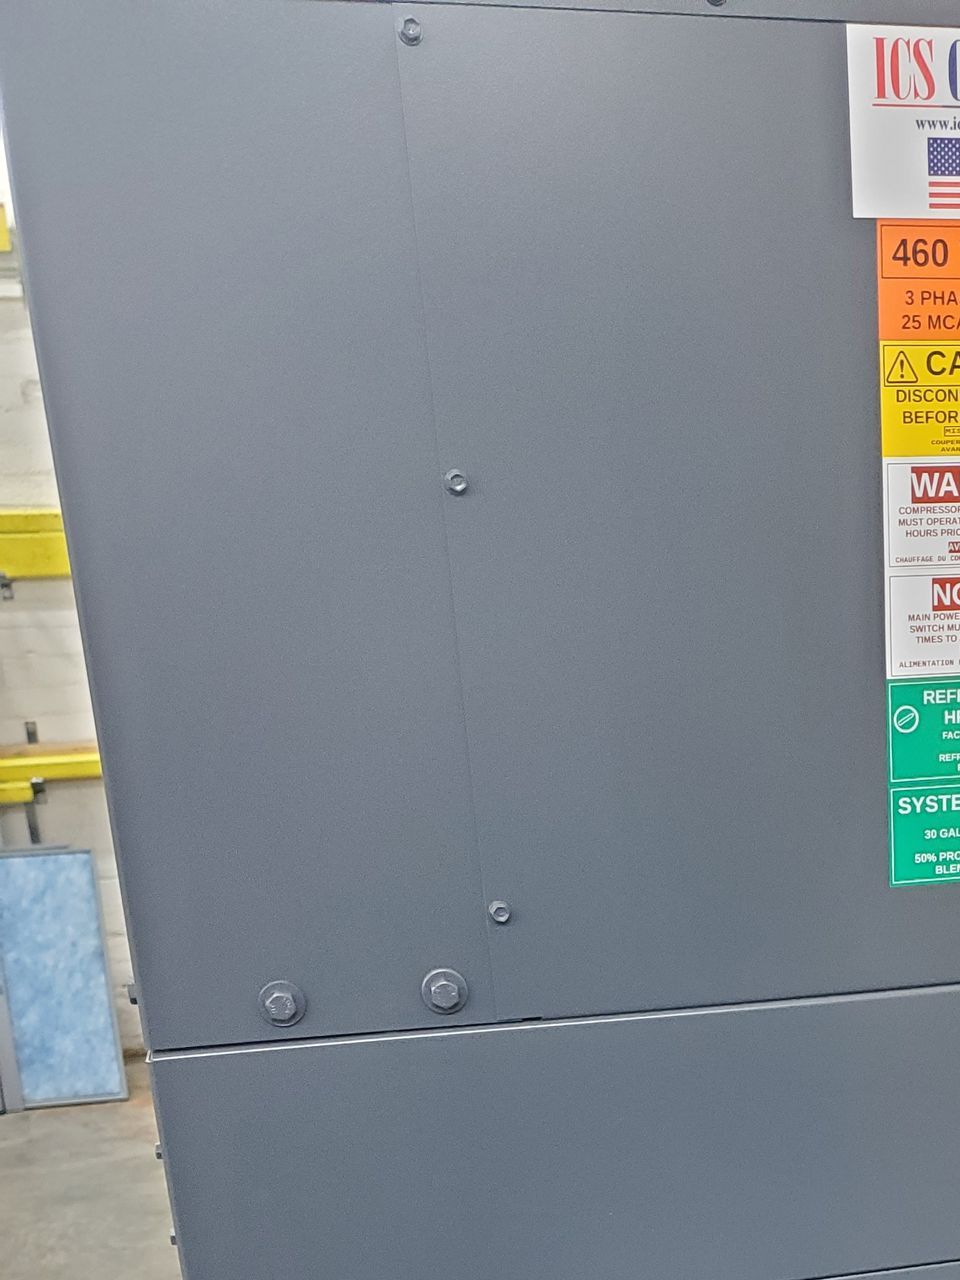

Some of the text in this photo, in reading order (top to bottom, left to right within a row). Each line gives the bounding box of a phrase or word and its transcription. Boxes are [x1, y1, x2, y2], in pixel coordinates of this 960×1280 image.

[872, 36, 936, 100] ICS
[892, 238, 949, 267] 460
[905, 291, 914, 305] 3
[902, 315, 921, 329] 25
[899, 518, 923, 526] MUST
[905, 529, 938, 537] HOURS
[908, 614, 930, 622] MAIN
[910, 624, 944, 633] SWITCH
[916, 635, 943, 644] TIMES
[946, 634, 957, 642] TO
[899, 659, 954, 668] ALIMENTATION
[924, 829, 937, 839] 30
[915, 853, 937, 864] 50%
